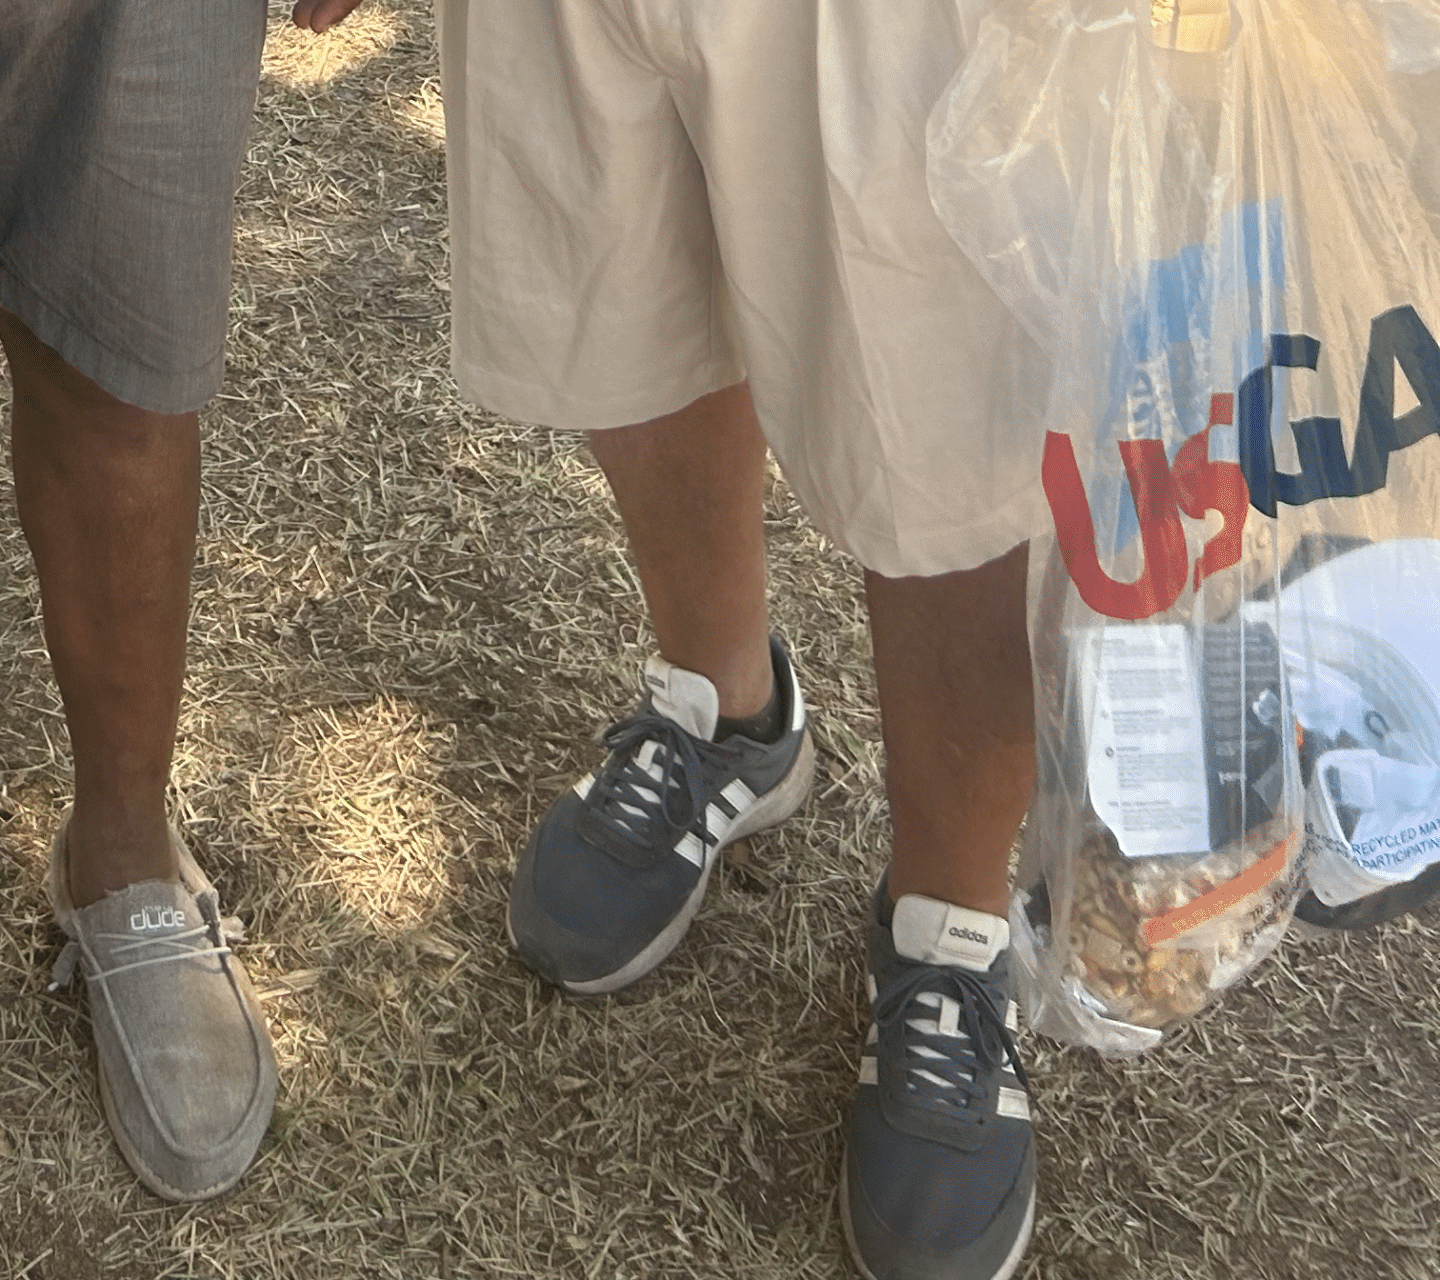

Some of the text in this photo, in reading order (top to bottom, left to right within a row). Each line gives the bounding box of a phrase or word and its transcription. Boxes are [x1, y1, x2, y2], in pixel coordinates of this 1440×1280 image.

[1041, 304, 1440, 620] USGA
[1352, 827, 1417, 855] RECYCLED
[130, 908, 186, 931] dude
[948, 925, 989, 945] adidas
